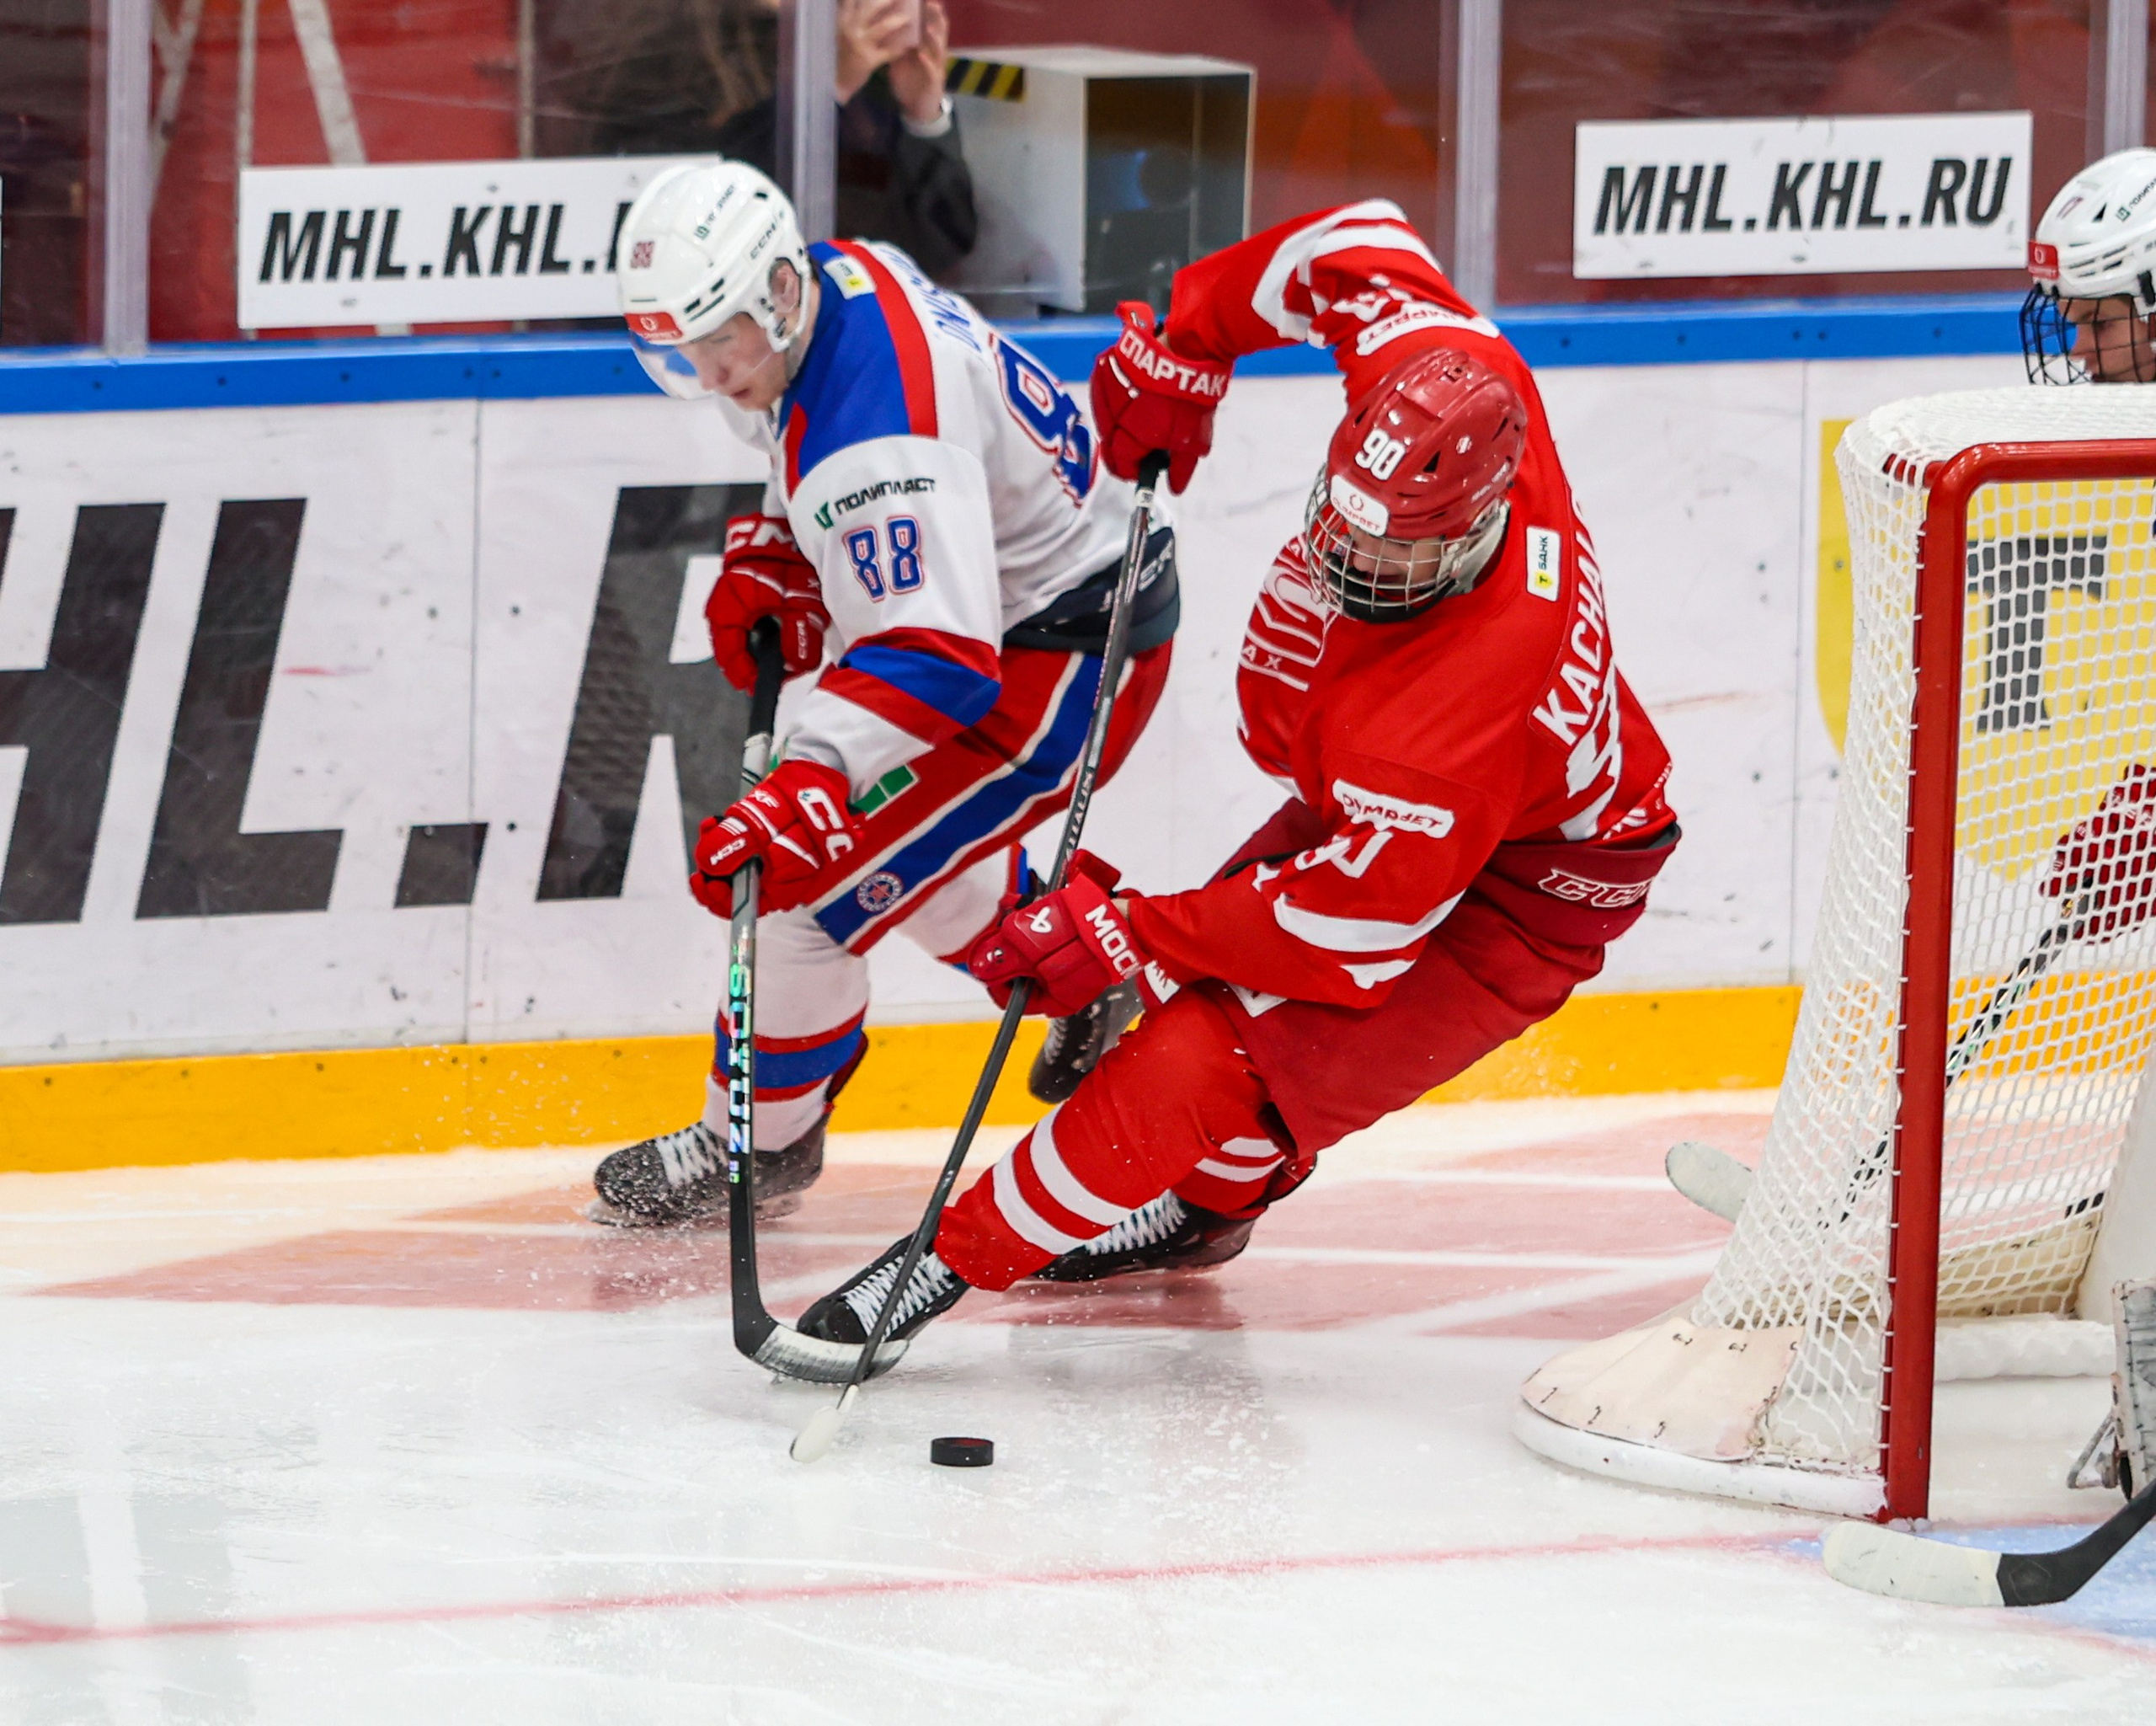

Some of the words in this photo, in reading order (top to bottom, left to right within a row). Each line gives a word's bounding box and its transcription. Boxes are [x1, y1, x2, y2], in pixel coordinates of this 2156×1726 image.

[1594, 157, 2012, 237] MHL.KHL.RU
[1119, 329, 1230, 398] СПАРТАК
[1354, 429, 1406, 482] 90
[835, 478, 937, 515] ПОЛИПЛАСТ
[843, 516, 924, 602] 88
[1533, 495, 1607, 746] KACHA
[728, 963, 751, 1154] SOYUZ
